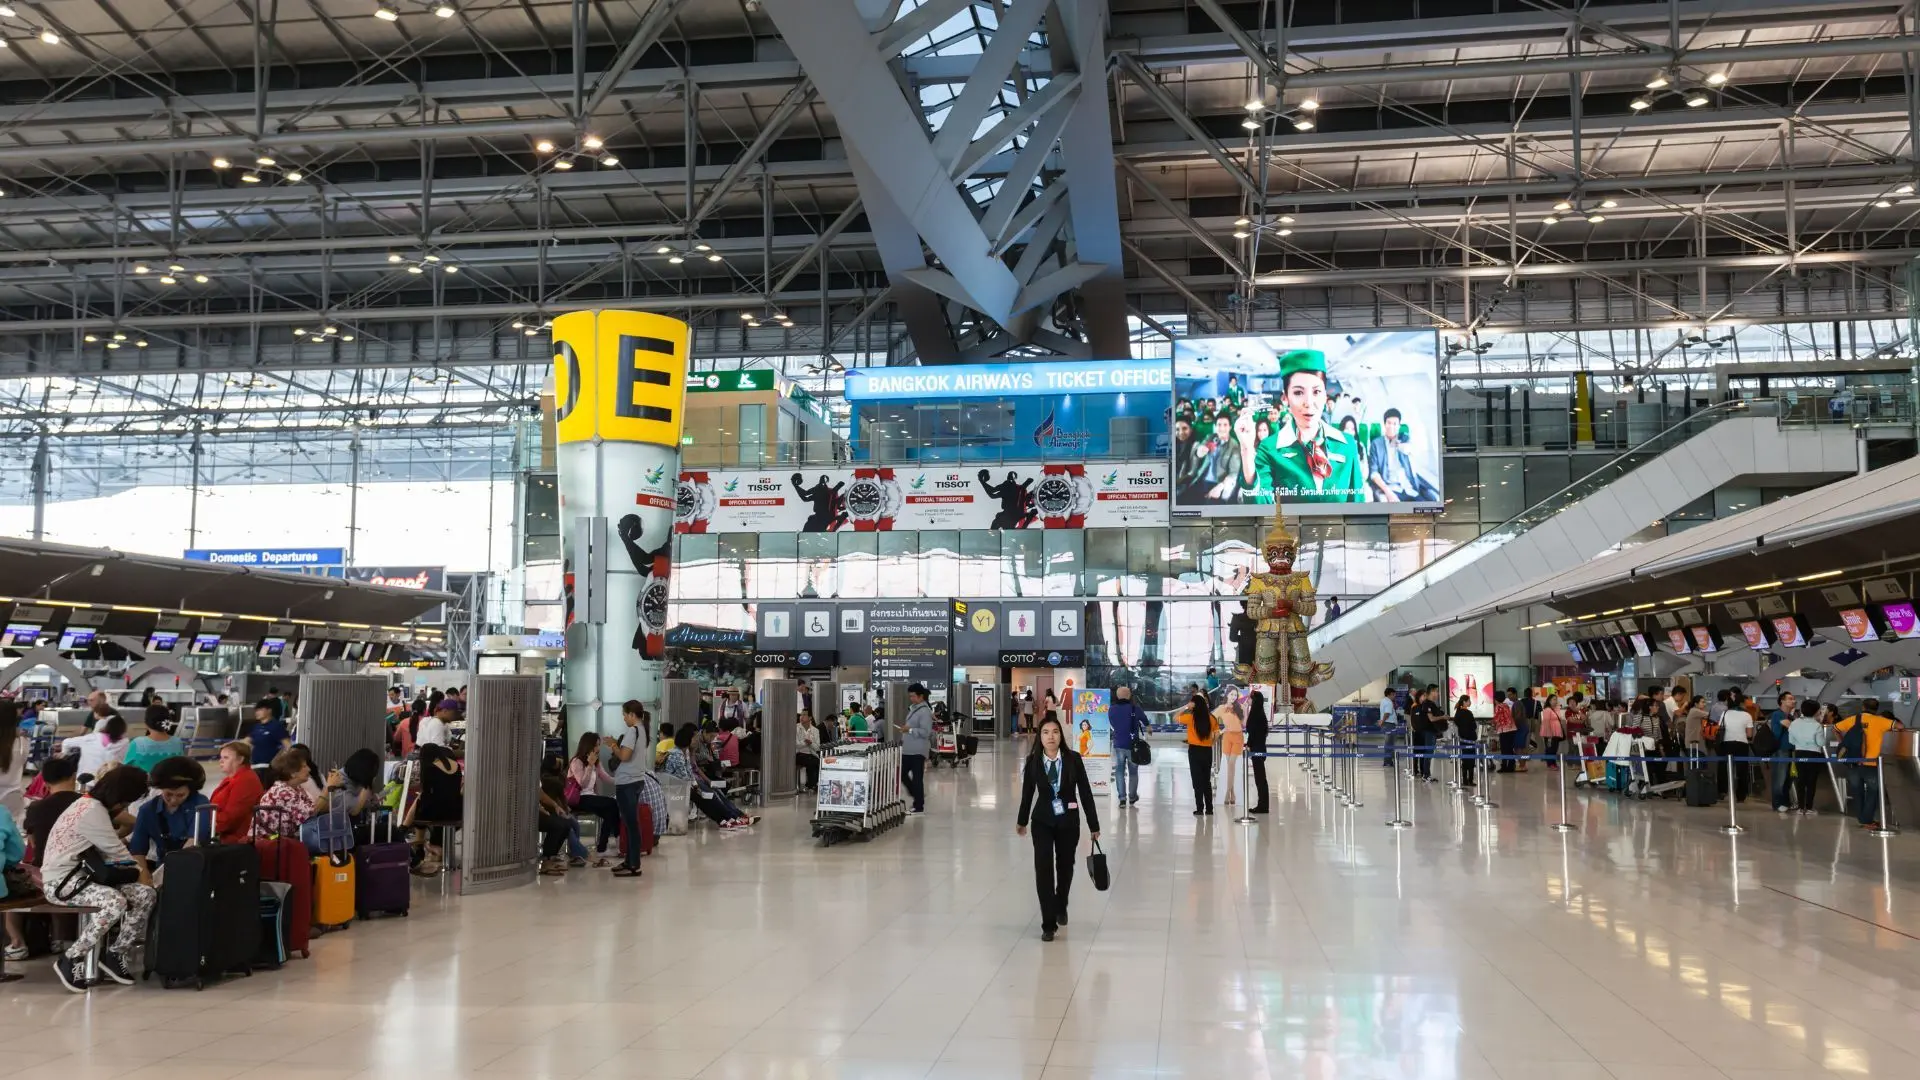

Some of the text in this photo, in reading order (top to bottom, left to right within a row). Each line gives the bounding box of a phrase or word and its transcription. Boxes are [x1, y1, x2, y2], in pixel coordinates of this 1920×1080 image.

[615, 334, 674, 423] E
[868, 370, 1170, 393] BANGKOK AIRWAYS TICKET OFFICE
[1055, 426, 1091, 441] Bangkok
[1048, 437, 1081, 450] Airways
[1127, 477, 1165, 485] TISSOT
[649, 498, 670, 507] OFFICIAL
[210, 551, 318, 564] Domestic Departures
[976, 616, 990, 627] Y1
[902, 625, 933, 633] Baggage
